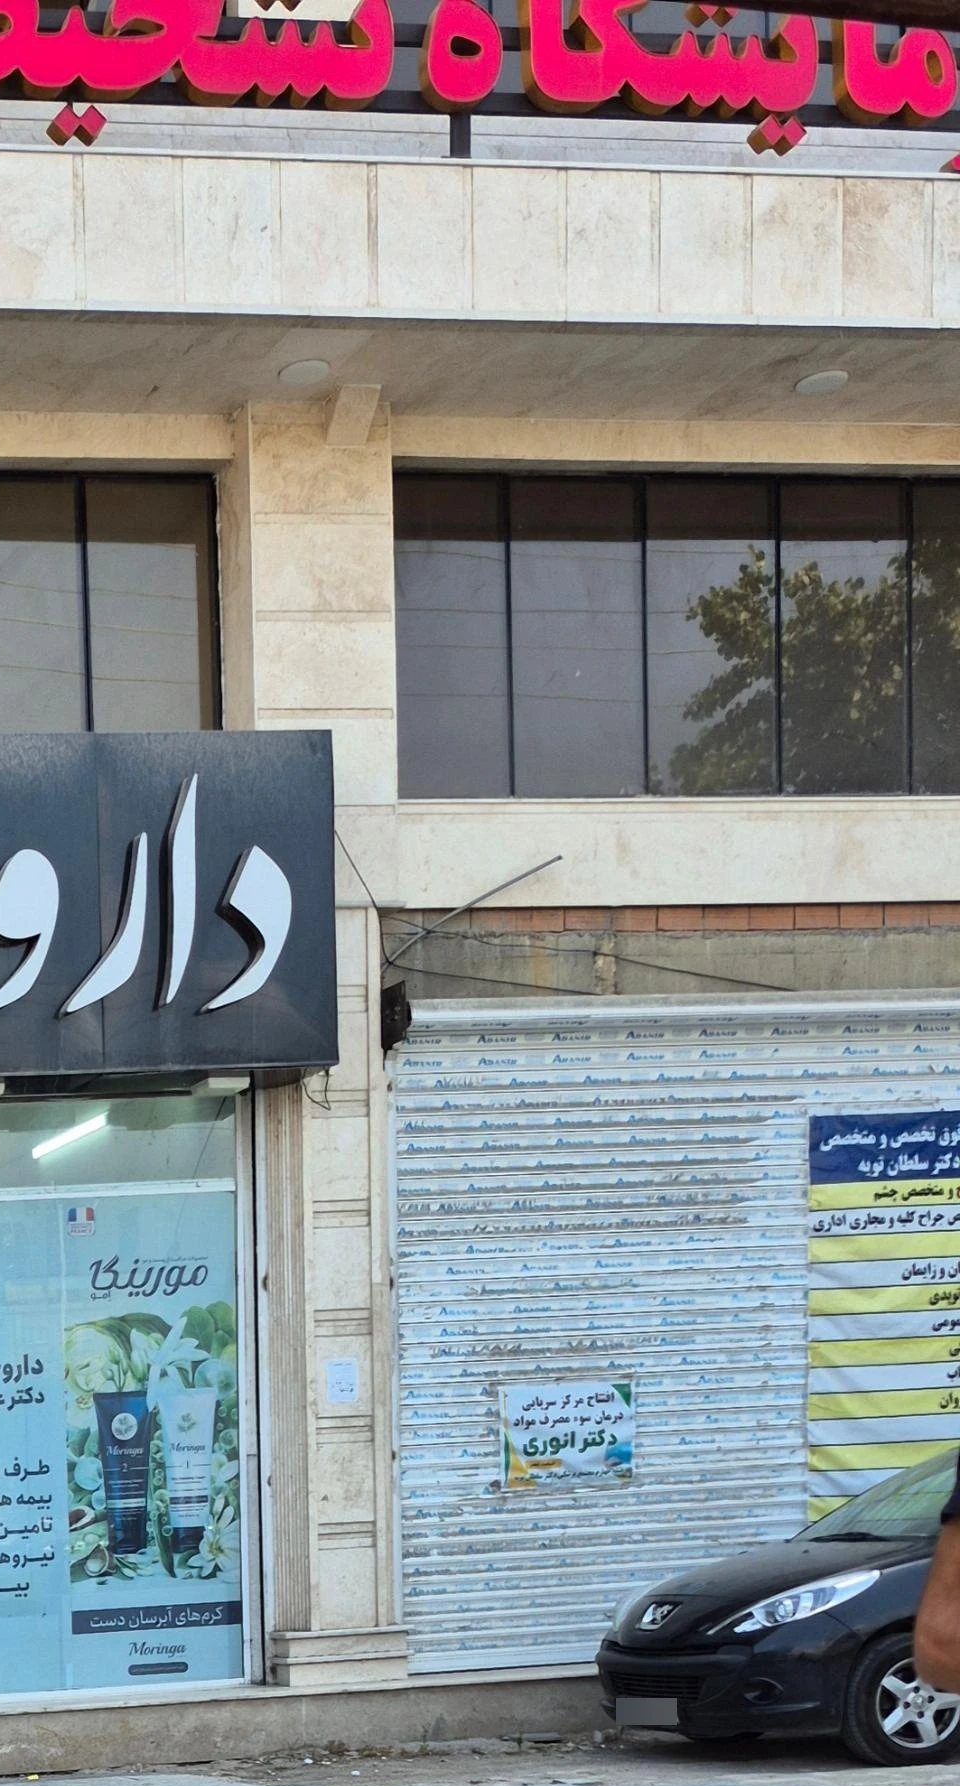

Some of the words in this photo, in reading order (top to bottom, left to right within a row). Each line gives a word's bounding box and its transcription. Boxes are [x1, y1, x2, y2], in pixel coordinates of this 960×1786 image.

[820, 1129, 877, 1152] متخصص
[878, 1133, 888, 1149] و
[890, 1126, 936, 1149] تخصص
[89, 1254, 208, 1297] مورینگا
[7, 1386, 45, 1411] دکتر
[513, 1415, 536, 1430] مواد
[539, 1413, 570, 1428] مصرف
[594, 1410, 624, 1425] درمان
[523, 1431, 576, 1457] انوری
[578, 1429, 617, 1453] دکتر
[4, 1457, 50, 1481] طرف
[16, 1493, 52, 1510] بیمه
[90, 1615, 126, 1628] دست
[128, 1607, 173, 1628] آبرسان
[128, 1641, 187, 1658] Moringa
